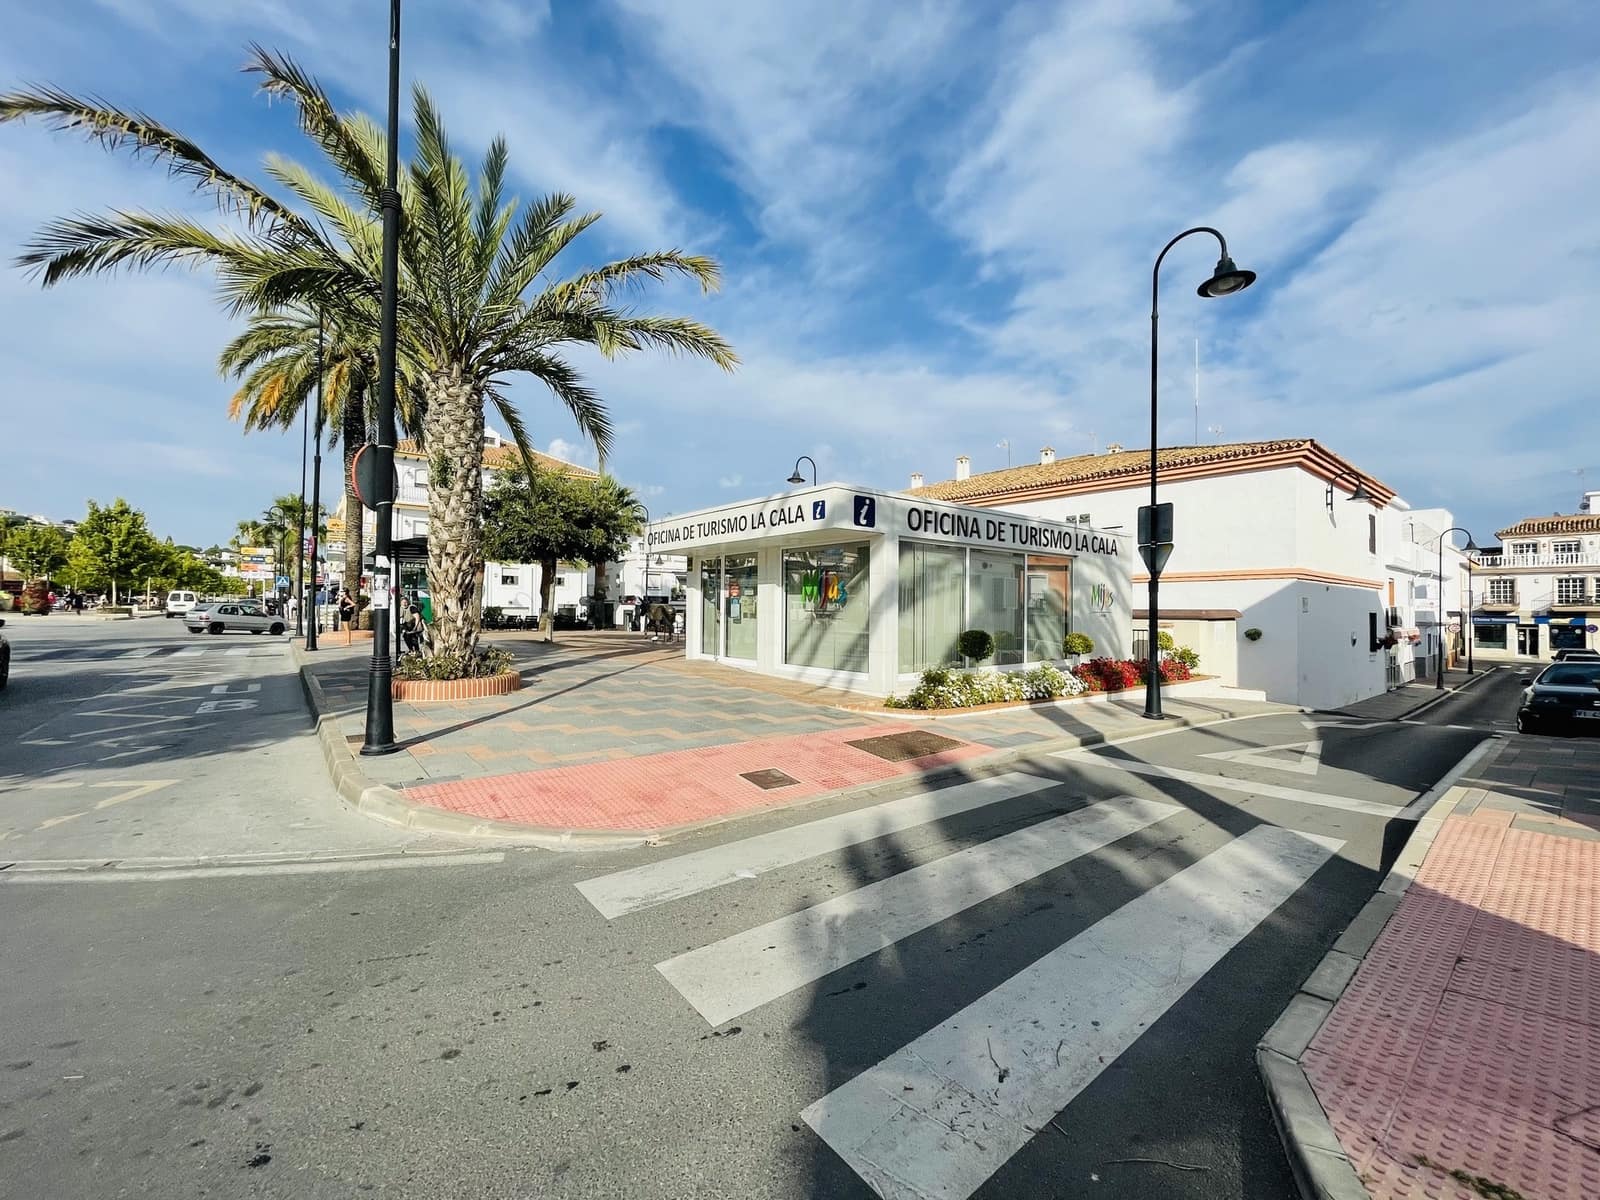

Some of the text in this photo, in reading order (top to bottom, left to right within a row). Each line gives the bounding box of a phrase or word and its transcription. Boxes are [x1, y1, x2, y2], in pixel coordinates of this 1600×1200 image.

[647, 505, 805, 546] OFICINA DE TURISMO LA CALA
[907, 507, 1118, 556] OFICINA DE TURISMO LA CALA
